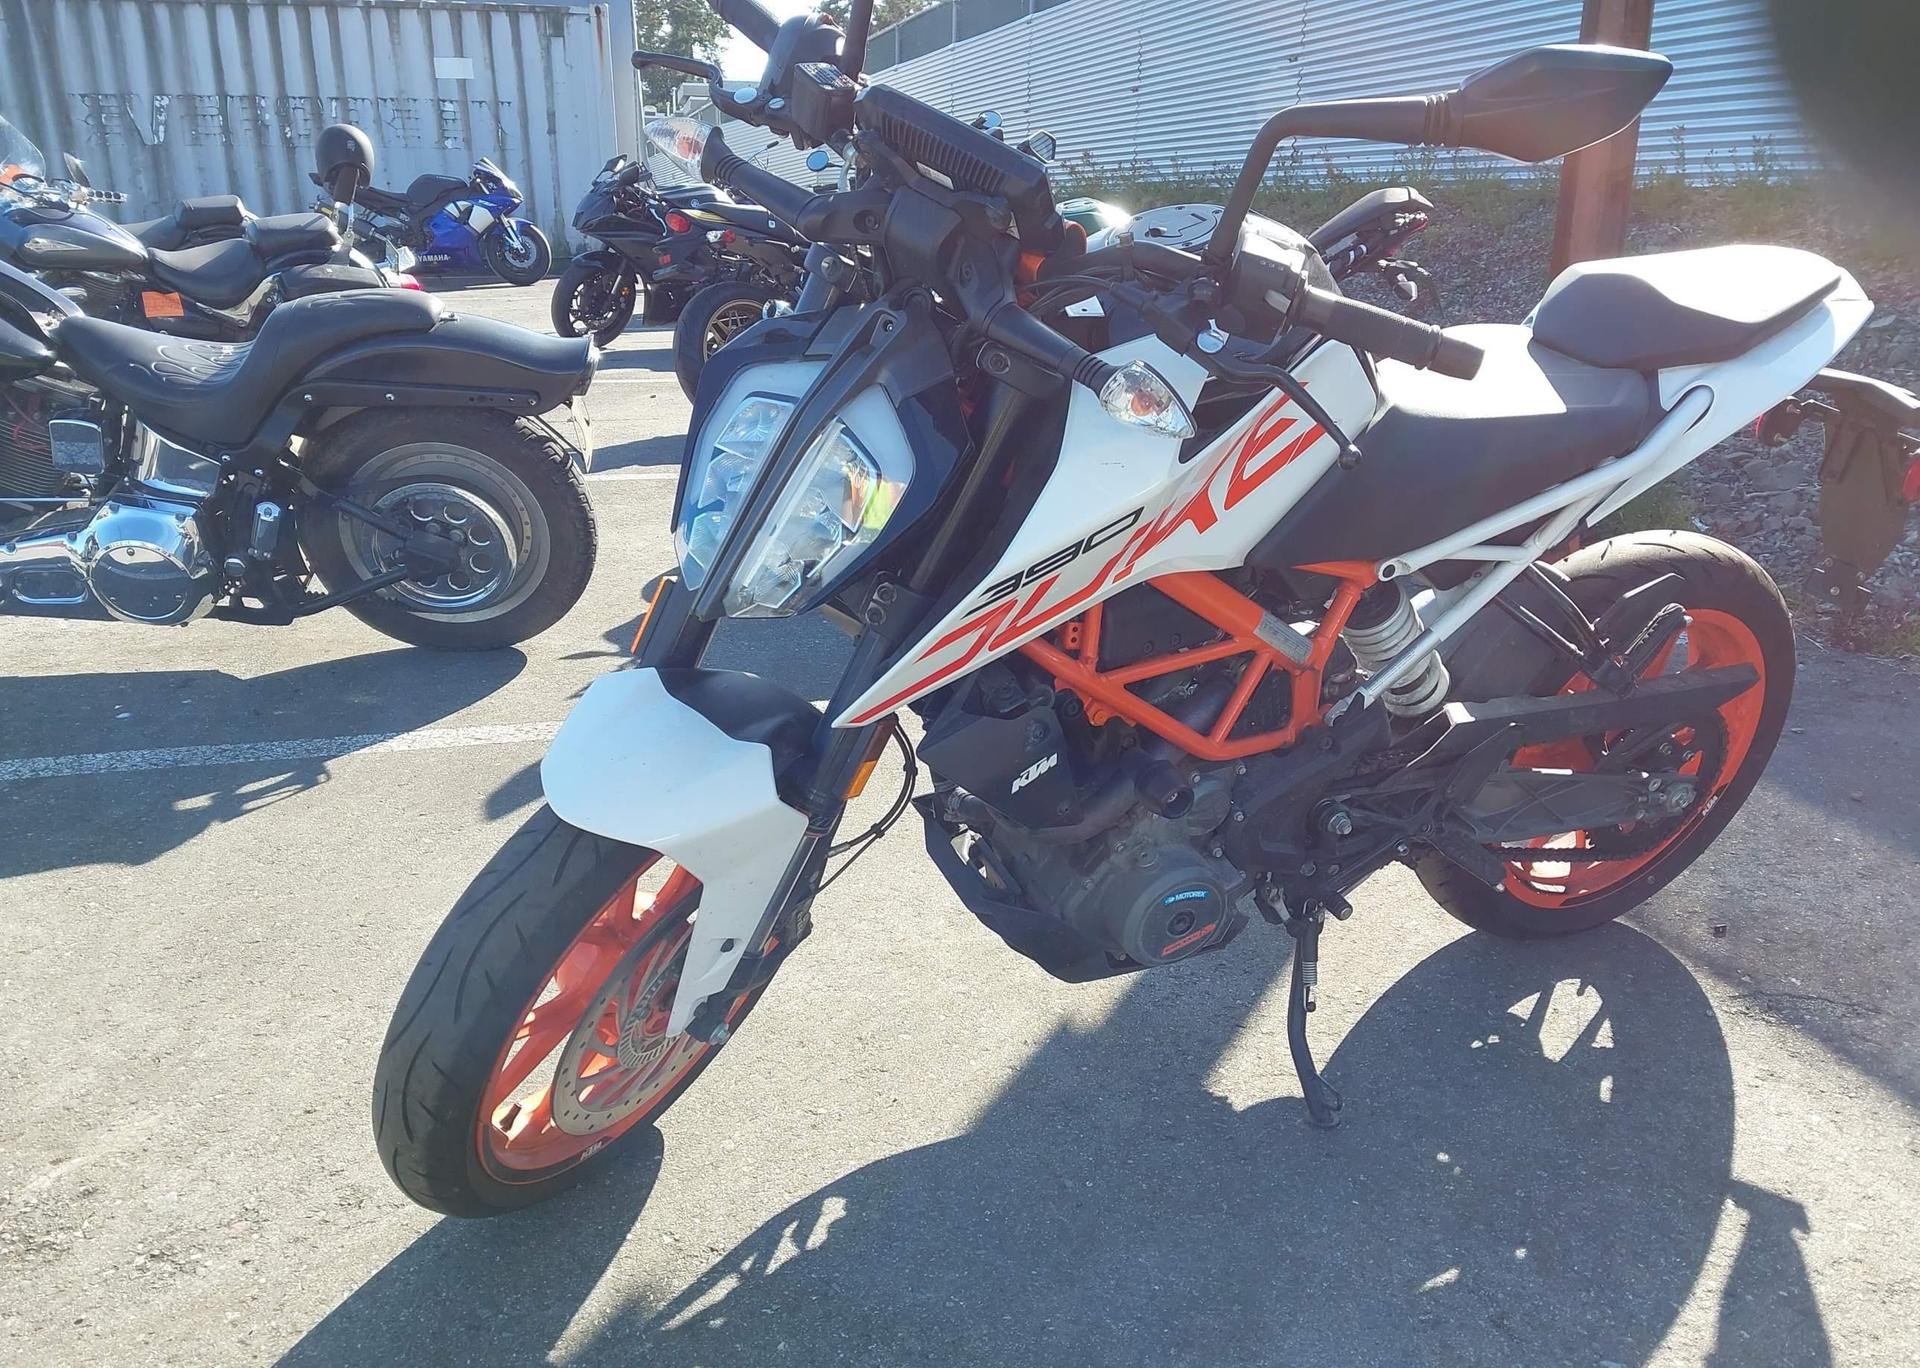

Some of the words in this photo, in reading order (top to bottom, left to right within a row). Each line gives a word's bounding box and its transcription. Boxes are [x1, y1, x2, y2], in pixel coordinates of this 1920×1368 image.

[417, 254, 449, 262] YAMAHA
[960, 505, 1145, 620] 390
[1011, 752, 1058, 795] KTM
